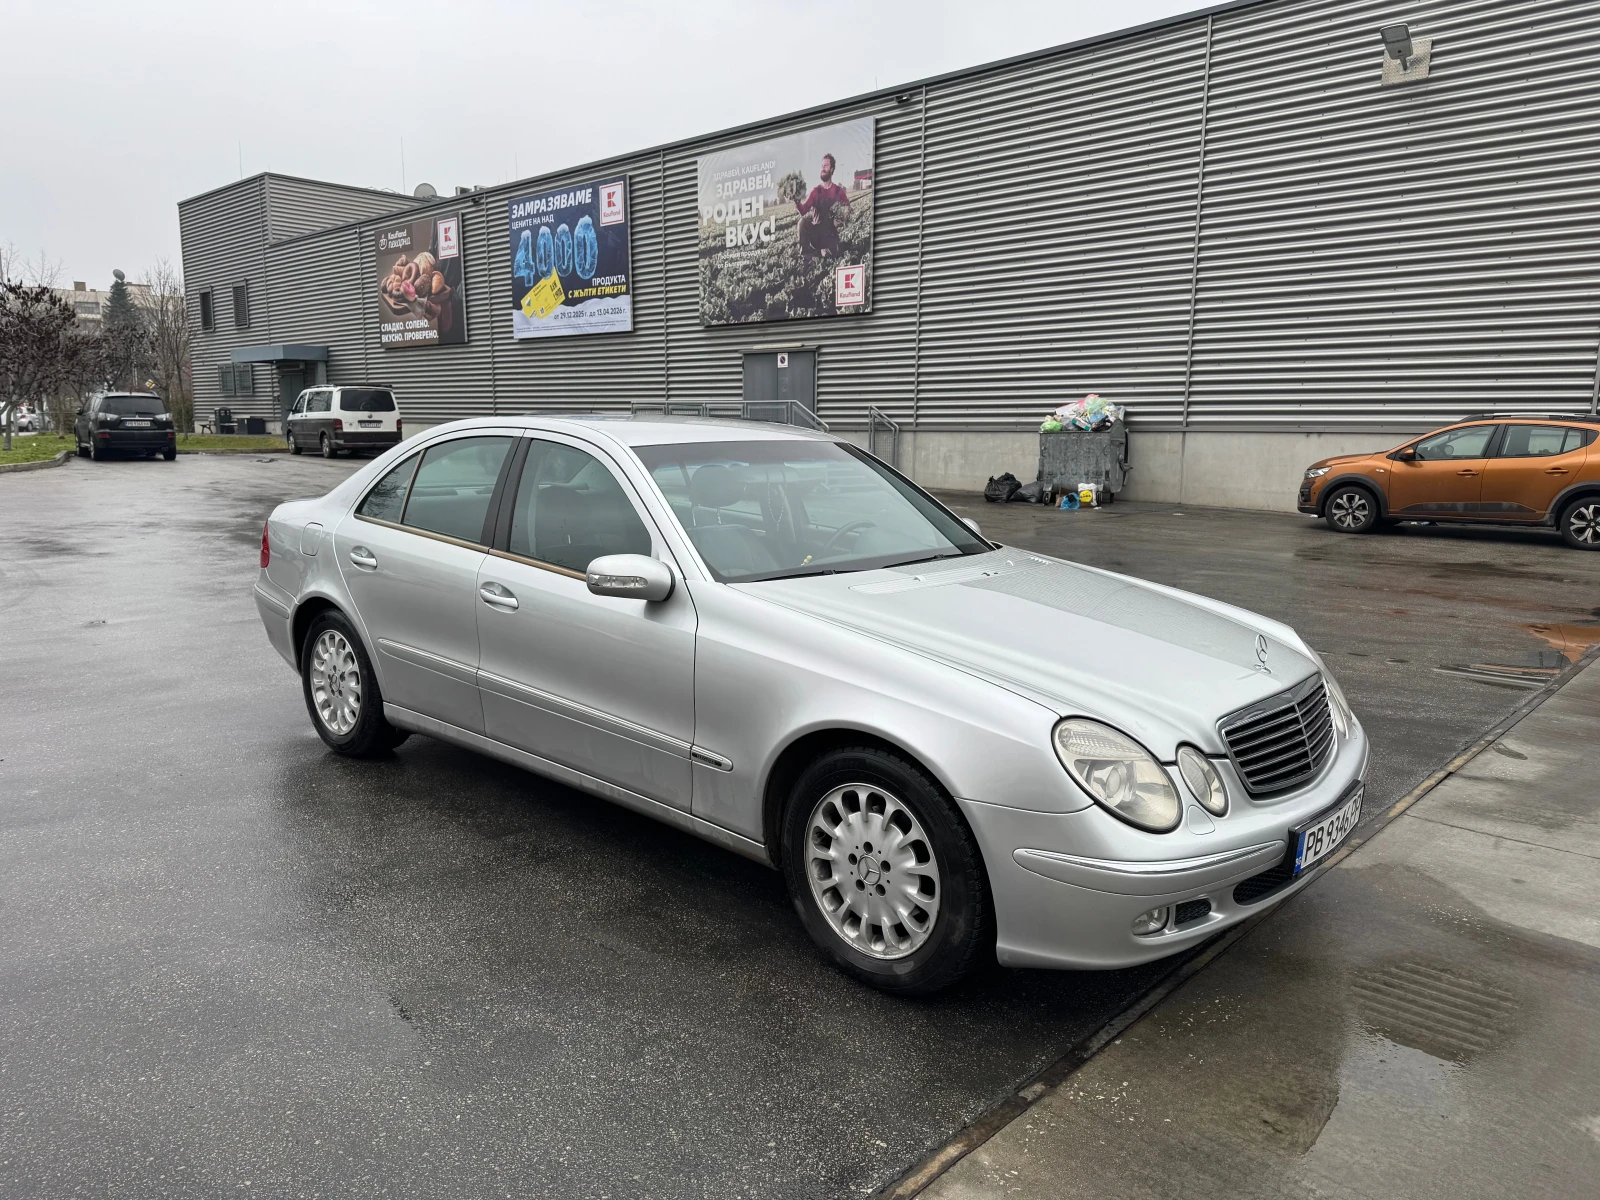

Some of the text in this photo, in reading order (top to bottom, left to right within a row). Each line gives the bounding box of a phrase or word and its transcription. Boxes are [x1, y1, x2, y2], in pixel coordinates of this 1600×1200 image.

[716, 169, 774, 199] ЗДРАВЕЙ,
[511, 187, 593, 218] ЗАМРАЗЯВАМЕ
[603, 210, 621, 218] Kaufland
[702, 195, 764, 226] РОДЕН
[511, 214, 555, 230] ЦЕНИТЕ НА НАД
[387, 228, 407, 240] Kaufland
[725, 215, 776, 248] ВКУС!
[513, 215, 599, 287] 4000
[592, 274, 626, 287] ПРОДУКТА
[568, 284, 627, 299] С ЖЪЛТИ ЕТИКЕТИ
[839, 290, 861, 299] Kaufland
[589, 311, 596, 319] до
[381, 321, 405, 333] СЛАДКО.
[381, 329, 439, 343] ВКУСНО. ПРОВЕРЕНО.
[1304, 826, 1325, 862] PB
[1326, 804, 1350, 849] 9346
